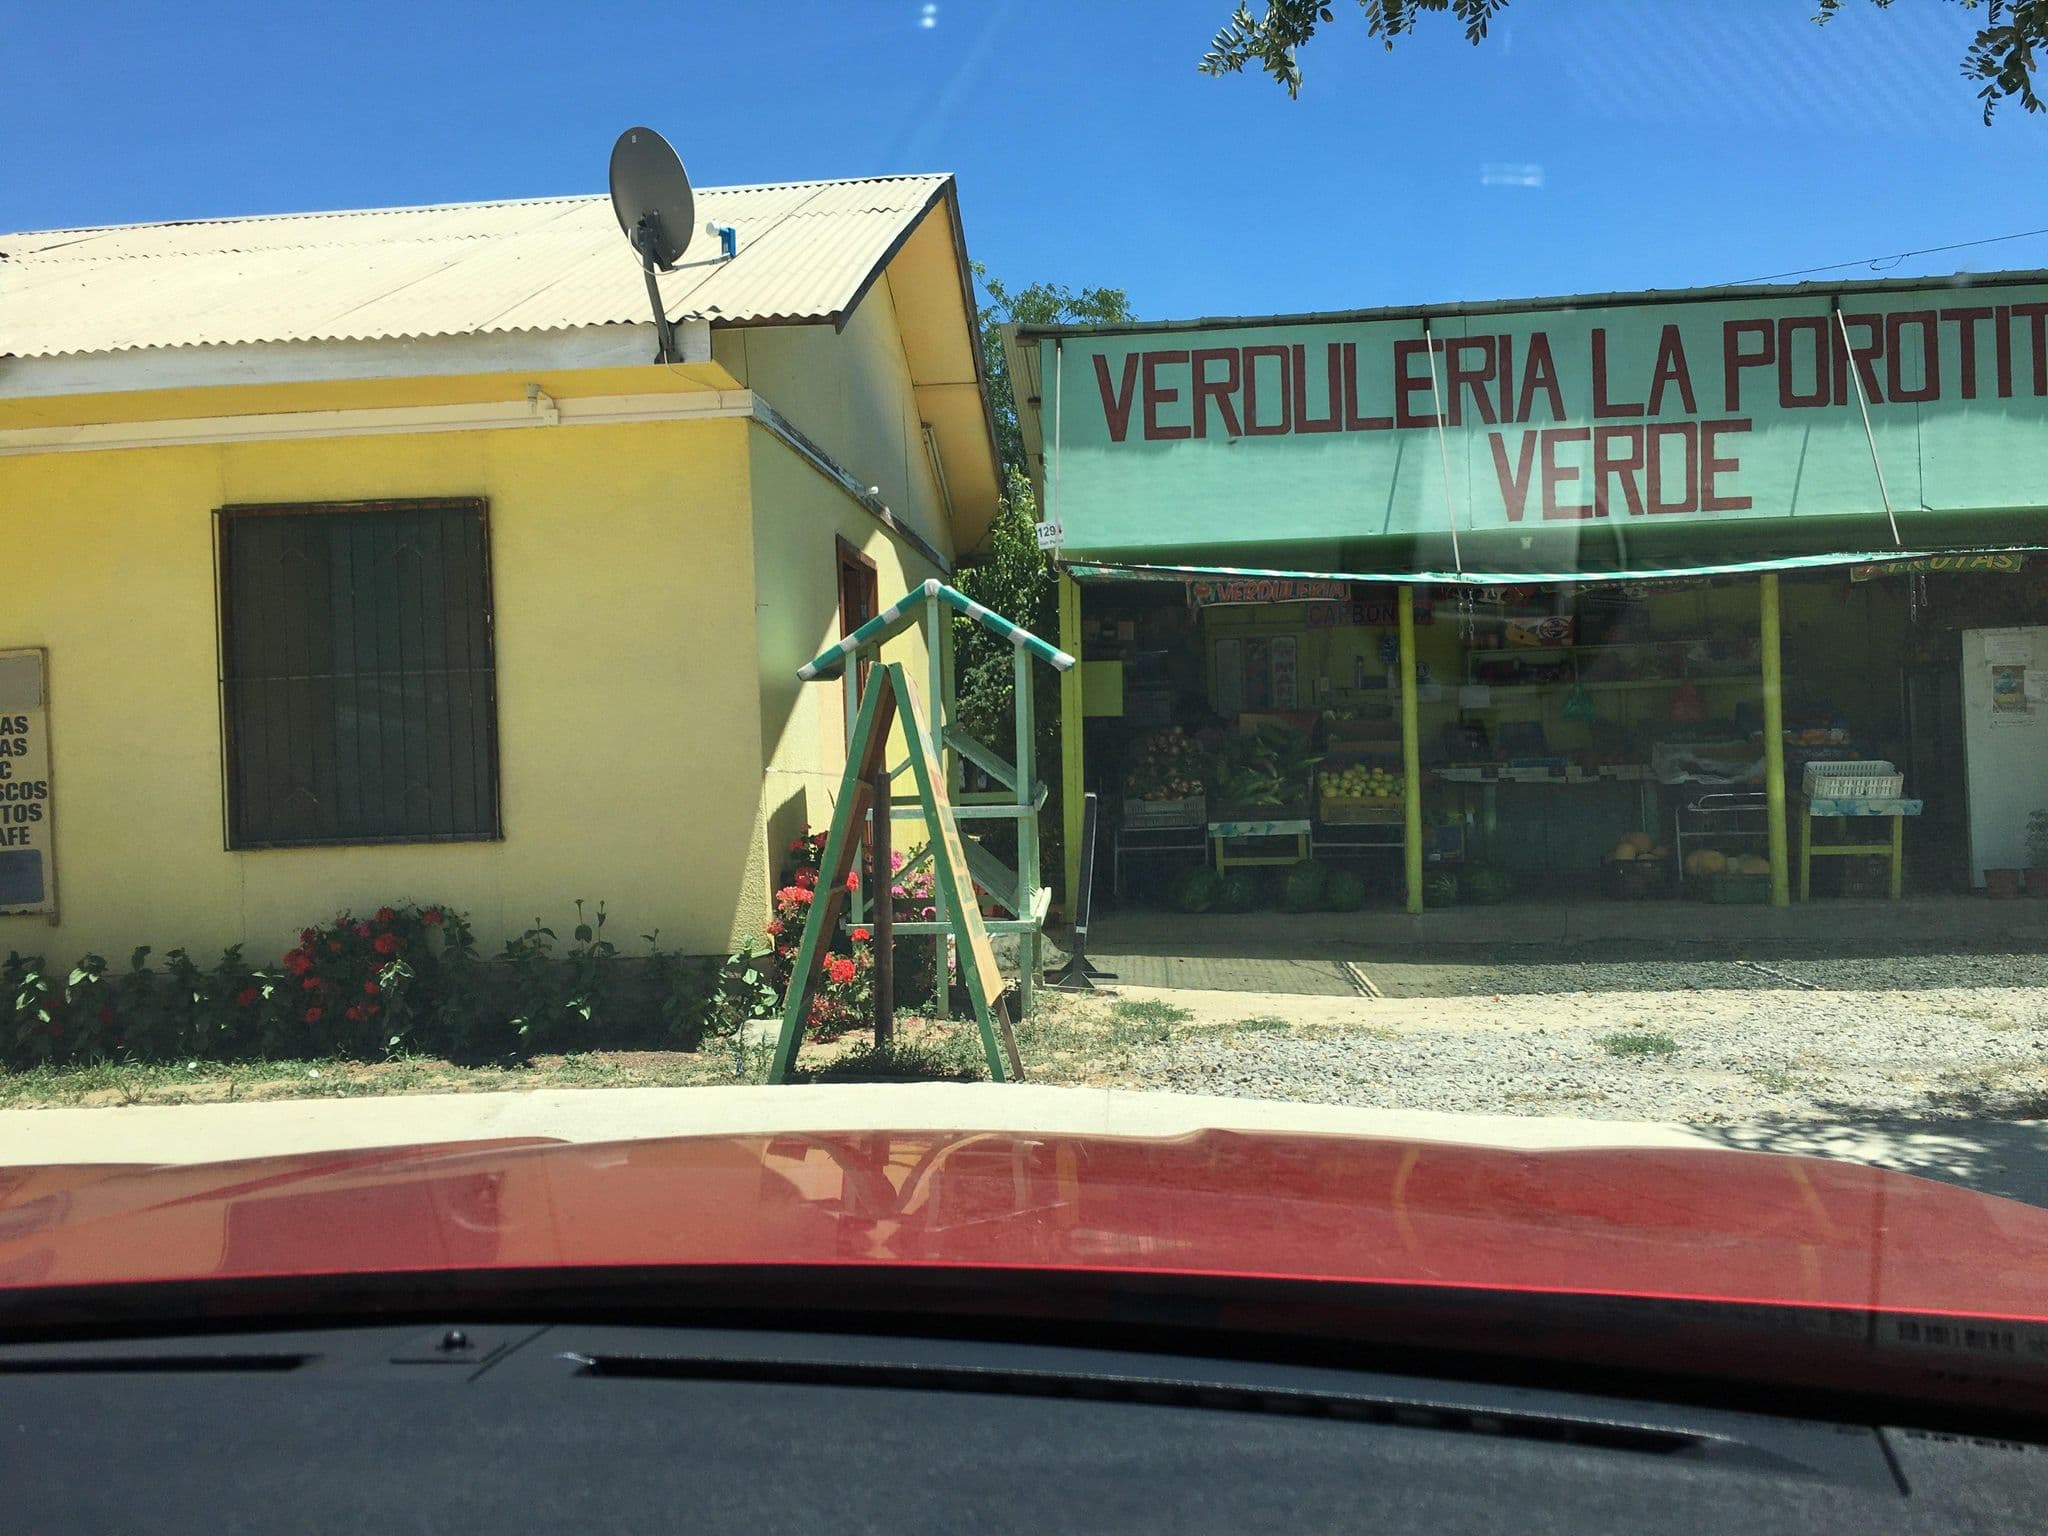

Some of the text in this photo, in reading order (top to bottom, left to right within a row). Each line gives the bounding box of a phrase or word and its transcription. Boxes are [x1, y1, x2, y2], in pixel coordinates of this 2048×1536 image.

[1092, 303, 2048, 442] VERDULERIA LA POROTIT
[1488, 418, 1752, 522] VERDE
